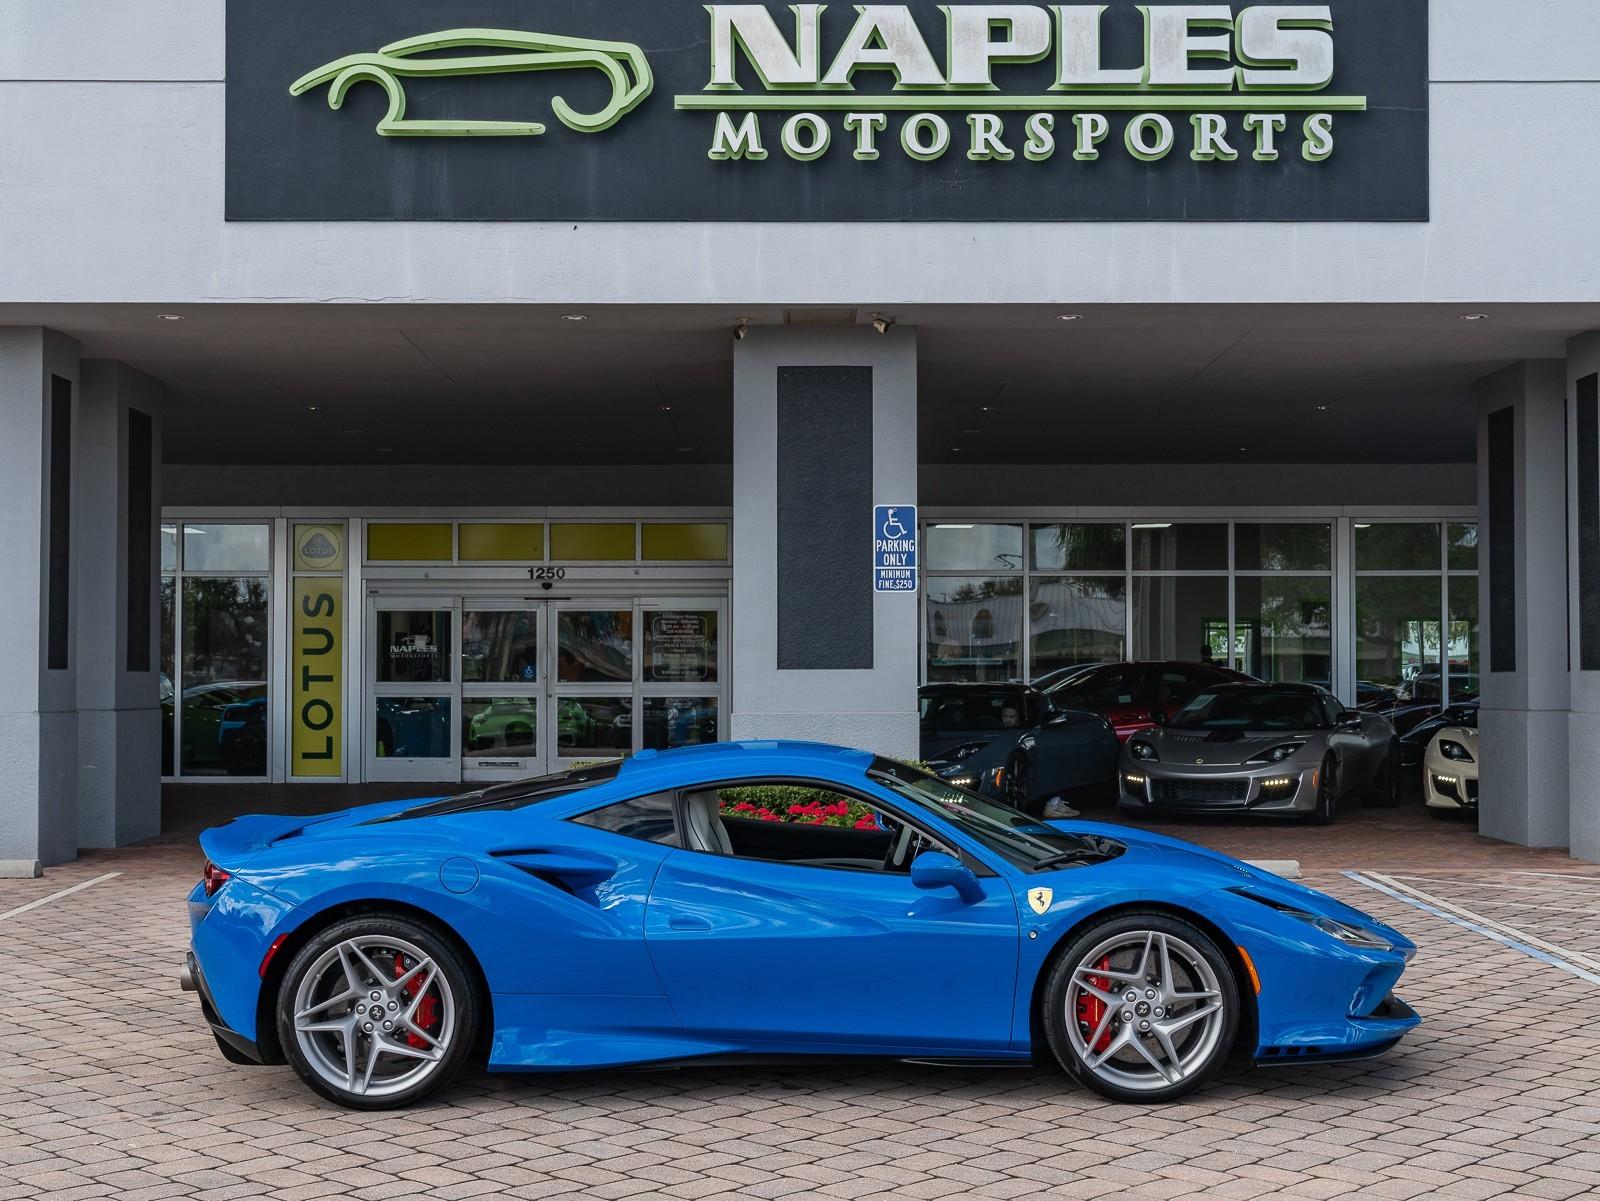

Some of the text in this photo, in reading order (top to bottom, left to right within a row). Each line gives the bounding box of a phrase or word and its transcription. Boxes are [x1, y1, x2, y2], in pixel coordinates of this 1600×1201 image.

[703, 4, 1334, 91] NAPLES
[708, 111, 1334, 162] MOTORSPORTS
[876, 540, 915, 552] PARKING
[883, 554, 907, 566] ONLY
[527, 567, 566, 579] 1250
[880, 570, 911, 578] MINIMUM
[896, 580, 913, 589] $250
[390, 645, 438, 653] NAPLES
[302, 593, 334, 760] LOTUS
